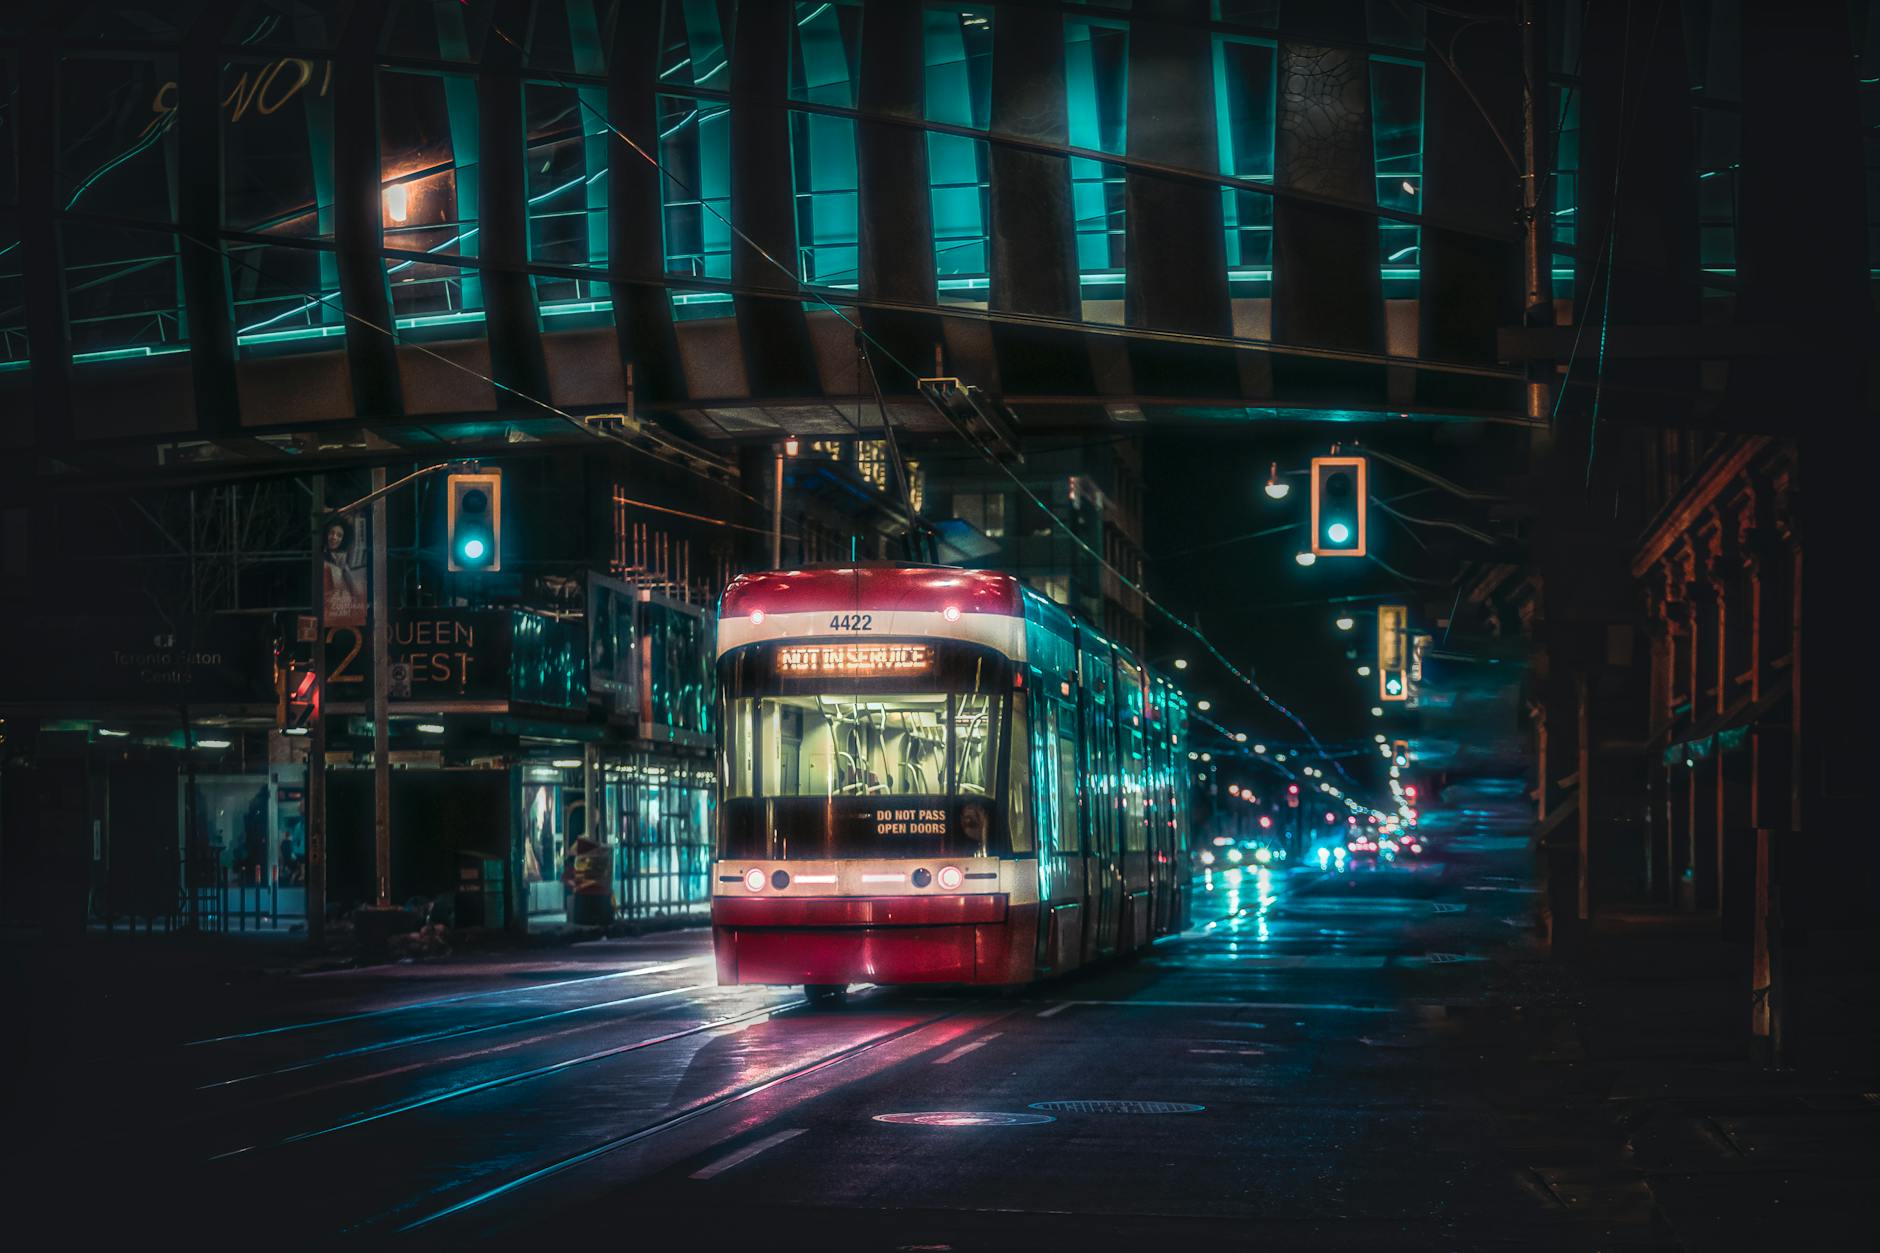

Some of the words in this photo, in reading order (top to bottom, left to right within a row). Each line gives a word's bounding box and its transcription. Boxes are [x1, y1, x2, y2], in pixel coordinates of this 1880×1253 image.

[830, 614, 872, 631] 4422
[325, 626, 365, 684] 2
[782, 648, 818, 670] NOT
[822, 648, 844, 670] IN
[847, 647, 926, 669] SERVICE
[876, 810, 892, 821] DO
[895, 810, 916, 821] NOT
[919, 810, 946, 821] PASS
[877, 823, 906, 834] OPEN
[910, 823, 946, 834] DOORS
